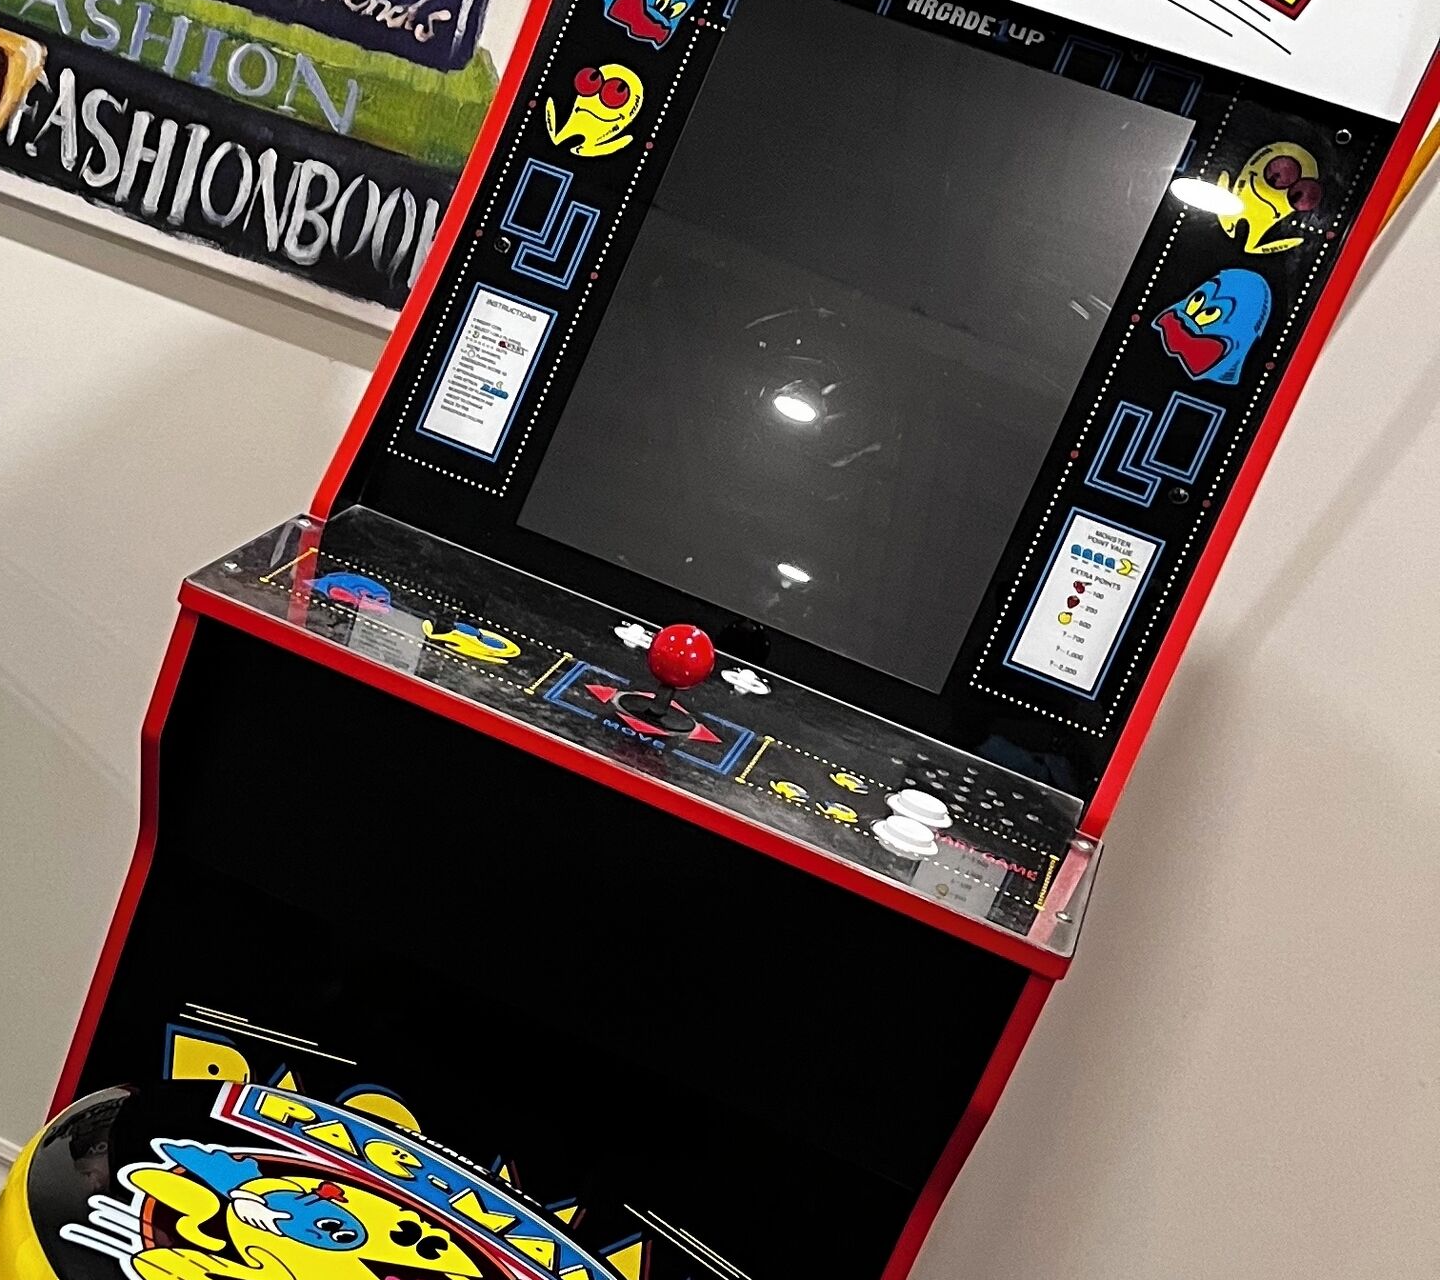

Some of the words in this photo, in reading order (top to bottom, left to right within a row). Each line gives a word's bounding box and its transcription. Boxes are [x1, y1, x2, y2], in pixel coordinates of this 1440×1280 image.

[485, 298, 537, 322] INSTRUCTIONS
[1087, 535, 1109, 547] POINT
[1110, 544, 1134, 556] VALUE
[1095, 530, 1132, 548] MONSTER
[1070, 567, 1093, 579] EXTRA
[1094, 576, 1121, 590] POINTS
